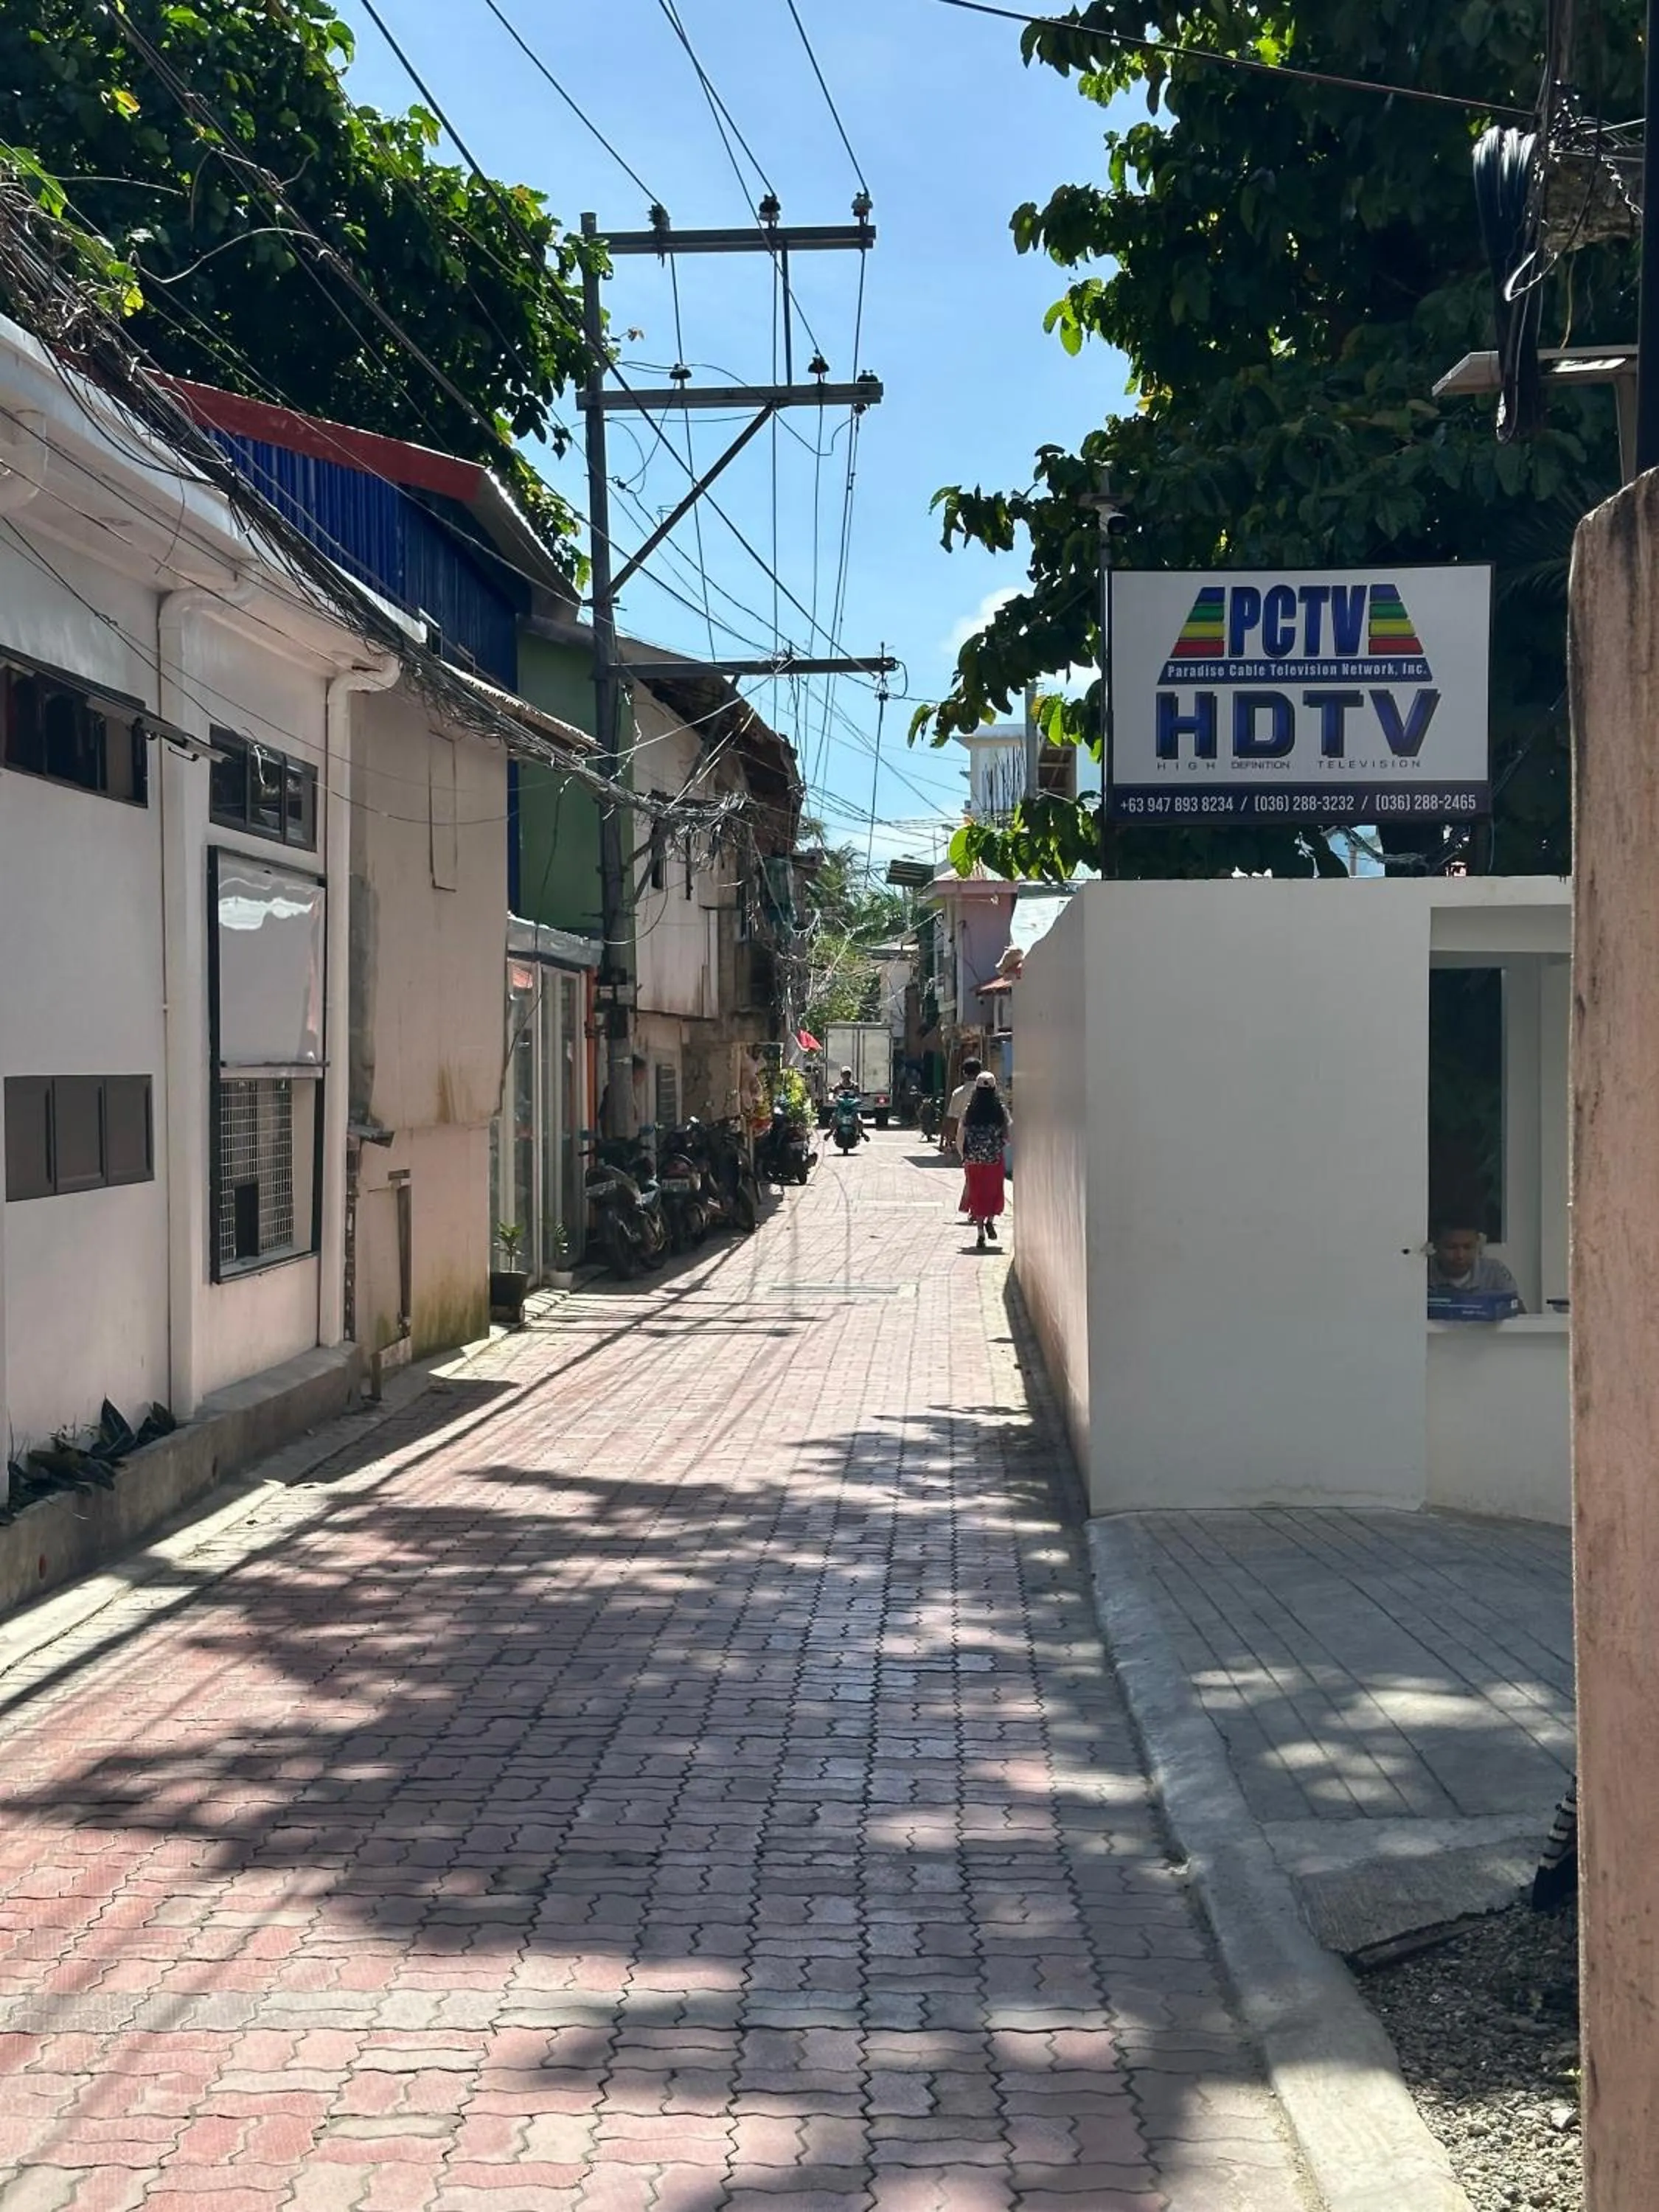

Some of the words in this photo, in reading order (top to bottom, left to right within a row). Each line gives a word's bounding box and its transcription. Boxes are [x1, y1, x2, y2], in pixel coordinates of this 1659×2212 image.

[1228, 585, 1368, 658] PCTV
[1167, 664, 1225, 678] Paradise
[1229, 664, 1266, 677] Cable
[1270, 664, 1338, 677] Television
[1342, 662, 1399, 676] Network,
[1402, 662, 1427, 675] Inc.
[1155, 689, 1441, 759] HDTV
[1231, 761, 1290, 770] DEFINITION
[1318, 759, 1422, 769] TELEVISION
[1121, 797, 1143, 813] +63
[1147, 797, 1171, 812] 947
[1201, 796, 1234, 812] 8234
[1240, 796, 1248, 810] /
[1254, 795, 1290, 812] (036)
[1293, 796, 1354, 811] 288-3232
[1361, 796, 1368, 811] /
[1413, 794, 1476, 810] 288-2465
